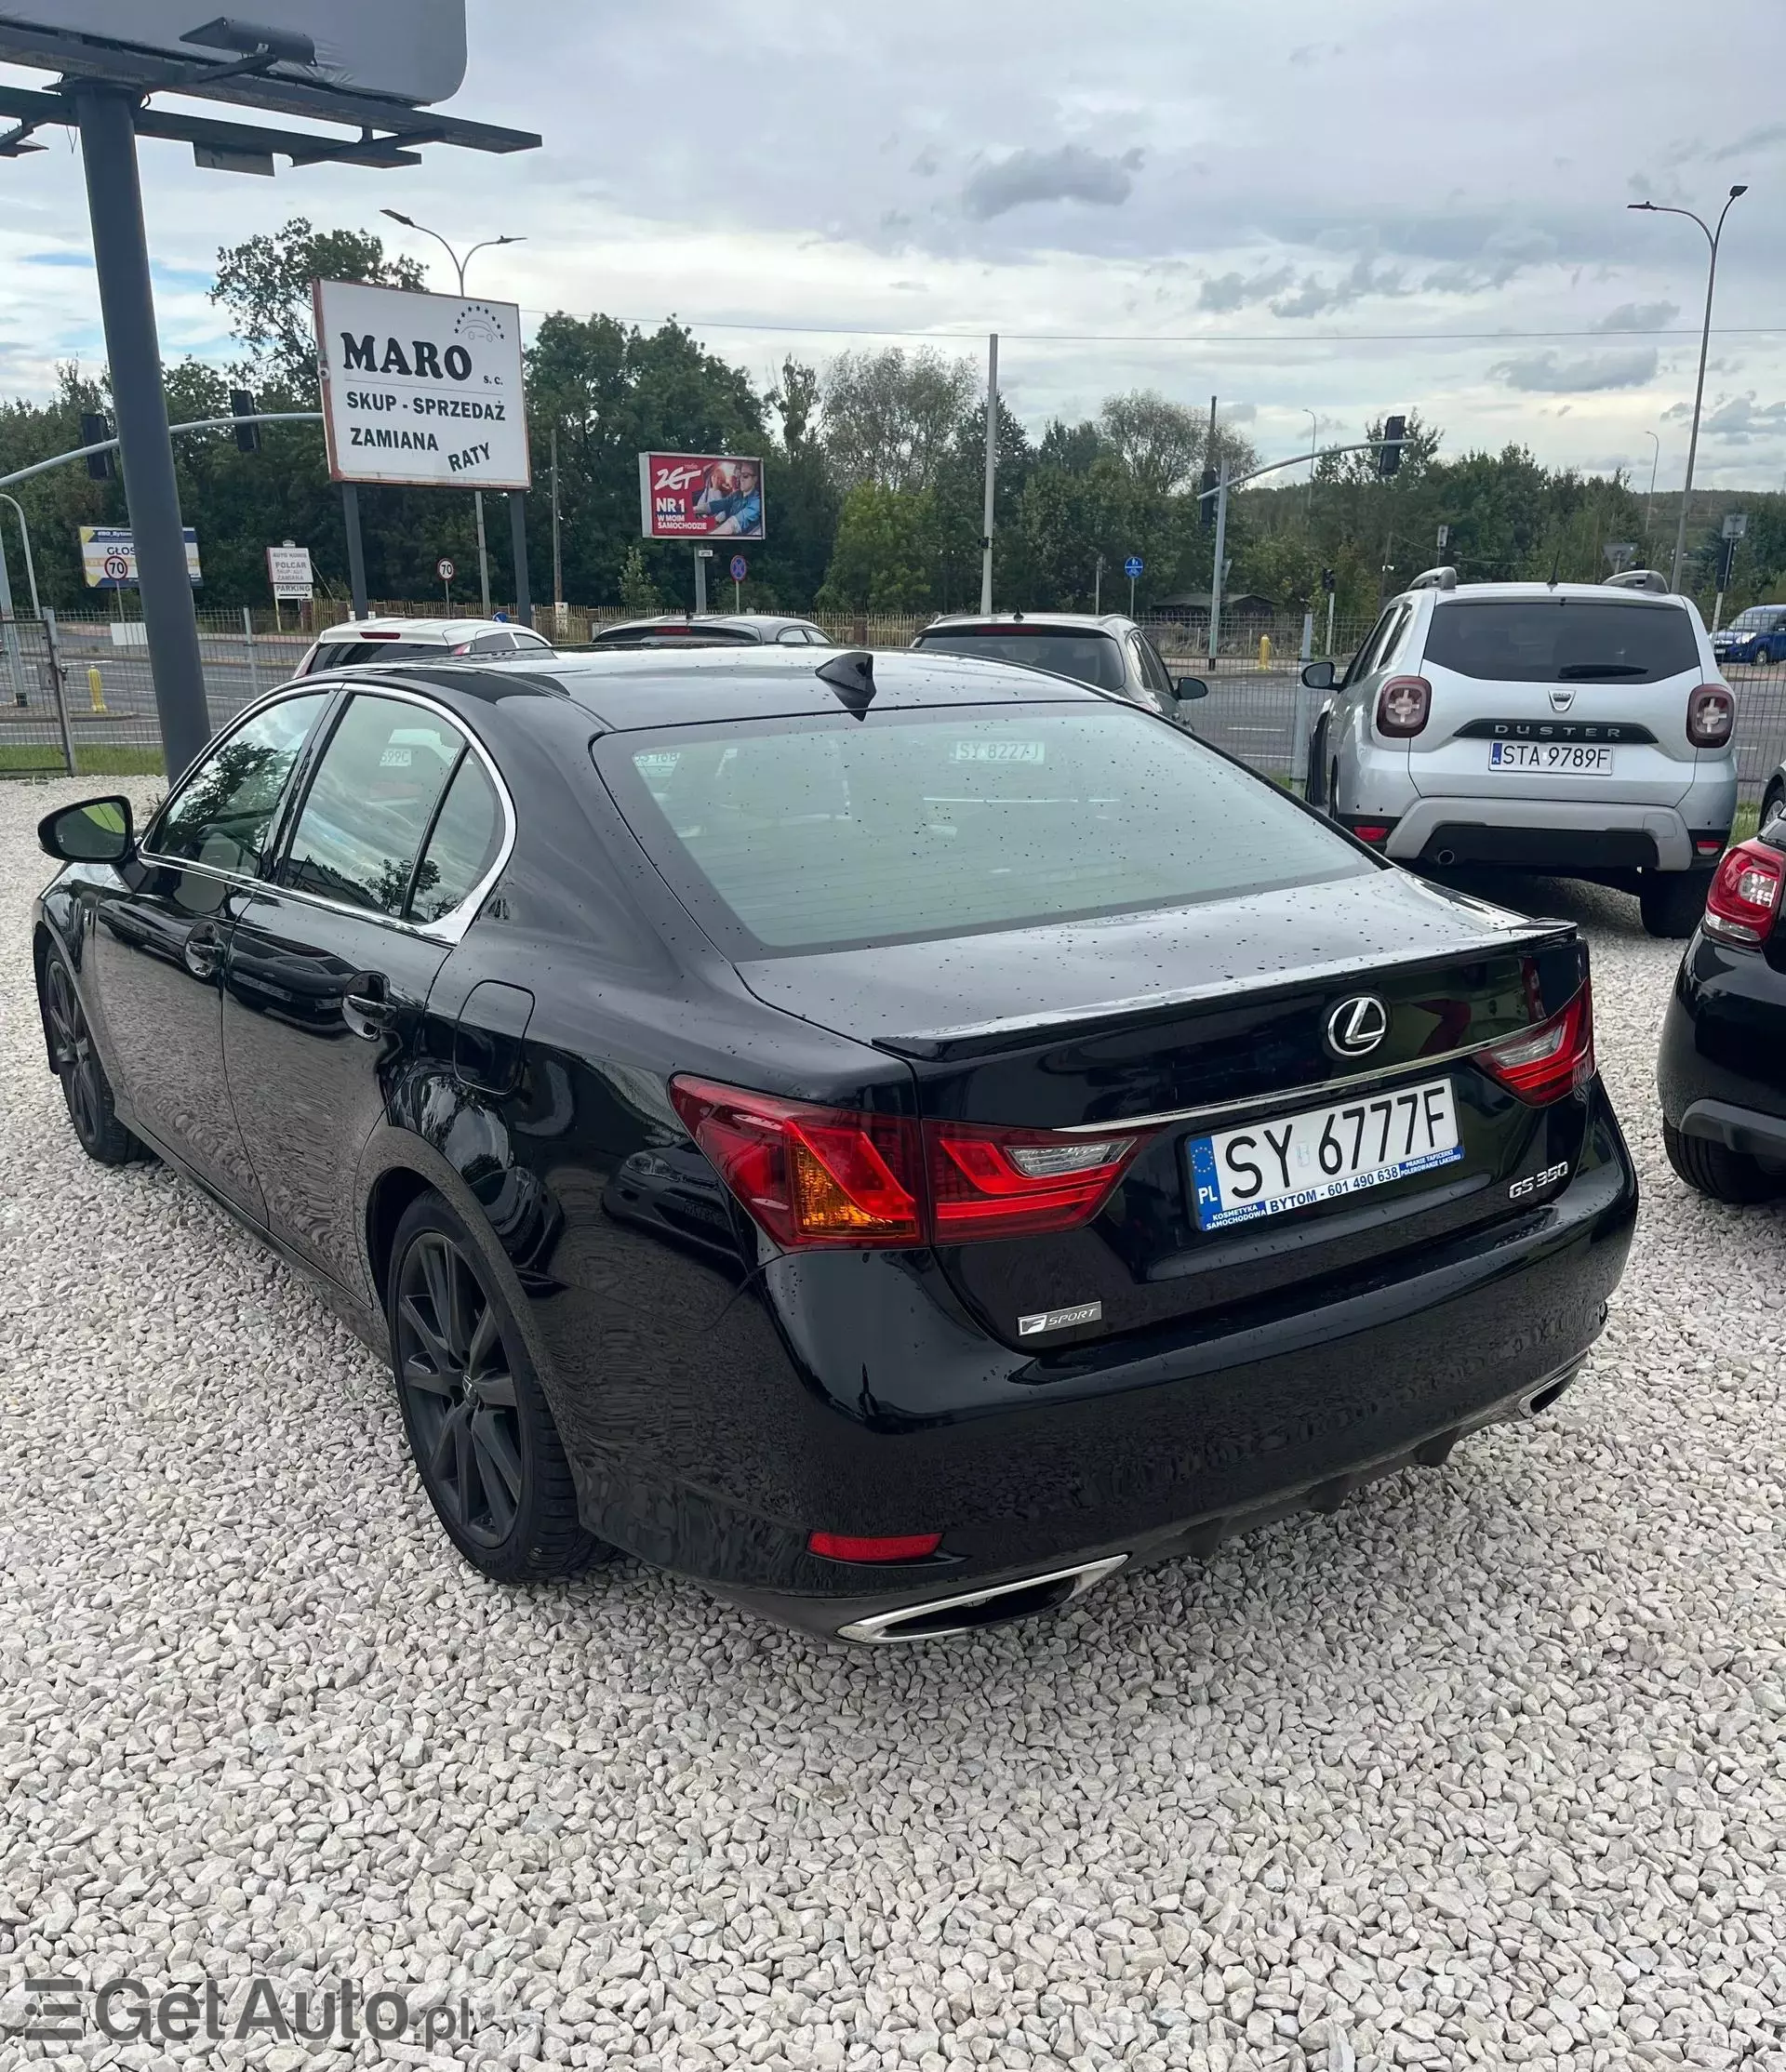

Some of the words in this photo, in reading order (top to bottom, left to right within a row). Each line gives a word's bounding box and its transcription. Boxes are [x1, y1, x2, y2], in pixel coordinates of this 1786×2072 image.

[340, 332, 473, 381] MARO
[346, 391, 397, 412] SKUP
[413, 397, 506, 421] SPRZEDAŻ
[350, 427, 439, 451] ZAMIANA
[447, 442, 491, 472] RATY
[654, 466, 701, 491] ZET
[656, 498, 676, 512] NR
[678, 498, 685, 512] 1
[658, 522, 707, 530] SAMOCHODZIE
[109, 562, 125, 574] 70
[441, 564, 452, 575] 70
[1495, 724, 1620, 737] DUSTER
[1502, 746, 1540, 766] STA
[1548, 747, 1611, 768] 9789F
[1198, 1186, 1218, 1204] PL
[1225, 1123, 1293, 1199] SY
[1318, 1086, 1446, 1175] 6777F
[1401, 1160, 1438, 1175] POLEROWANIE
[1406, 1157, 1426, 1168] PRANIE
[1270, 1189, 1317, 1213] BYTOM
[1327, 1182, 1348, 1197] 601
[1353, 1175, 1374, 1189] 490
[1378, 1166, 1399, 1182] 638
[1509, 1176, 1534, 1199] GS
[1537, 1162, 1568, 1188] 350
[1206, 1210, 1266, 1230] SAMOCHODOWA
[1212, 1204, 1258, 1221] KOSMETYKA
[1048, 1308, 1097, 1326] SPORT
